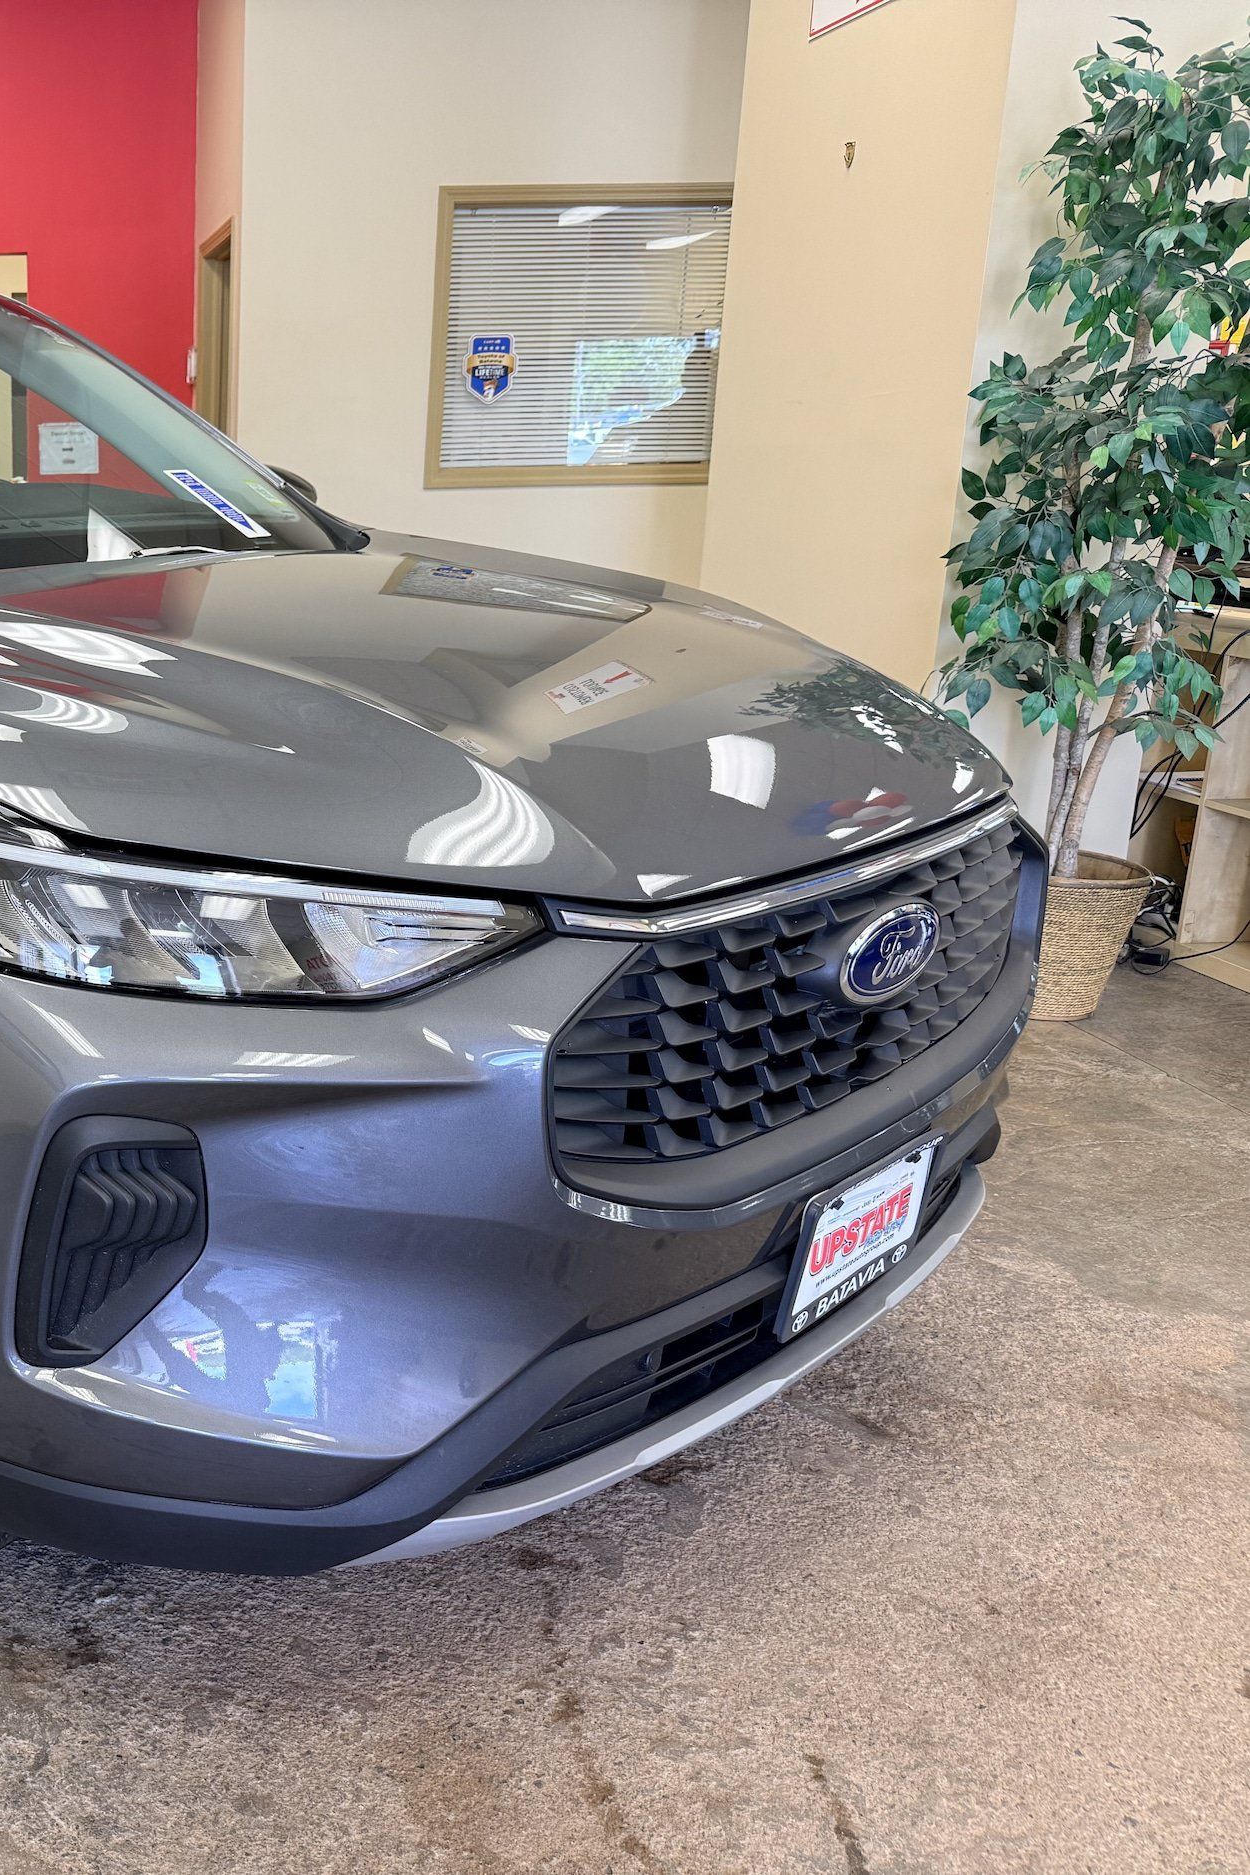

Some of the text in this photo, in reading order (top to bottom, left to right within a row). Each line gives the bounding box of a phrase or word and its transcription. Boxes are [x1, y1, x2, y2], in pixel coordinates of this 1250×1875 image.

[871, 925, 926, 986] Ford
[808, 1182, 914, 1277] UPSTATE
[814, 1257, 886, 1319] BATAVIA
